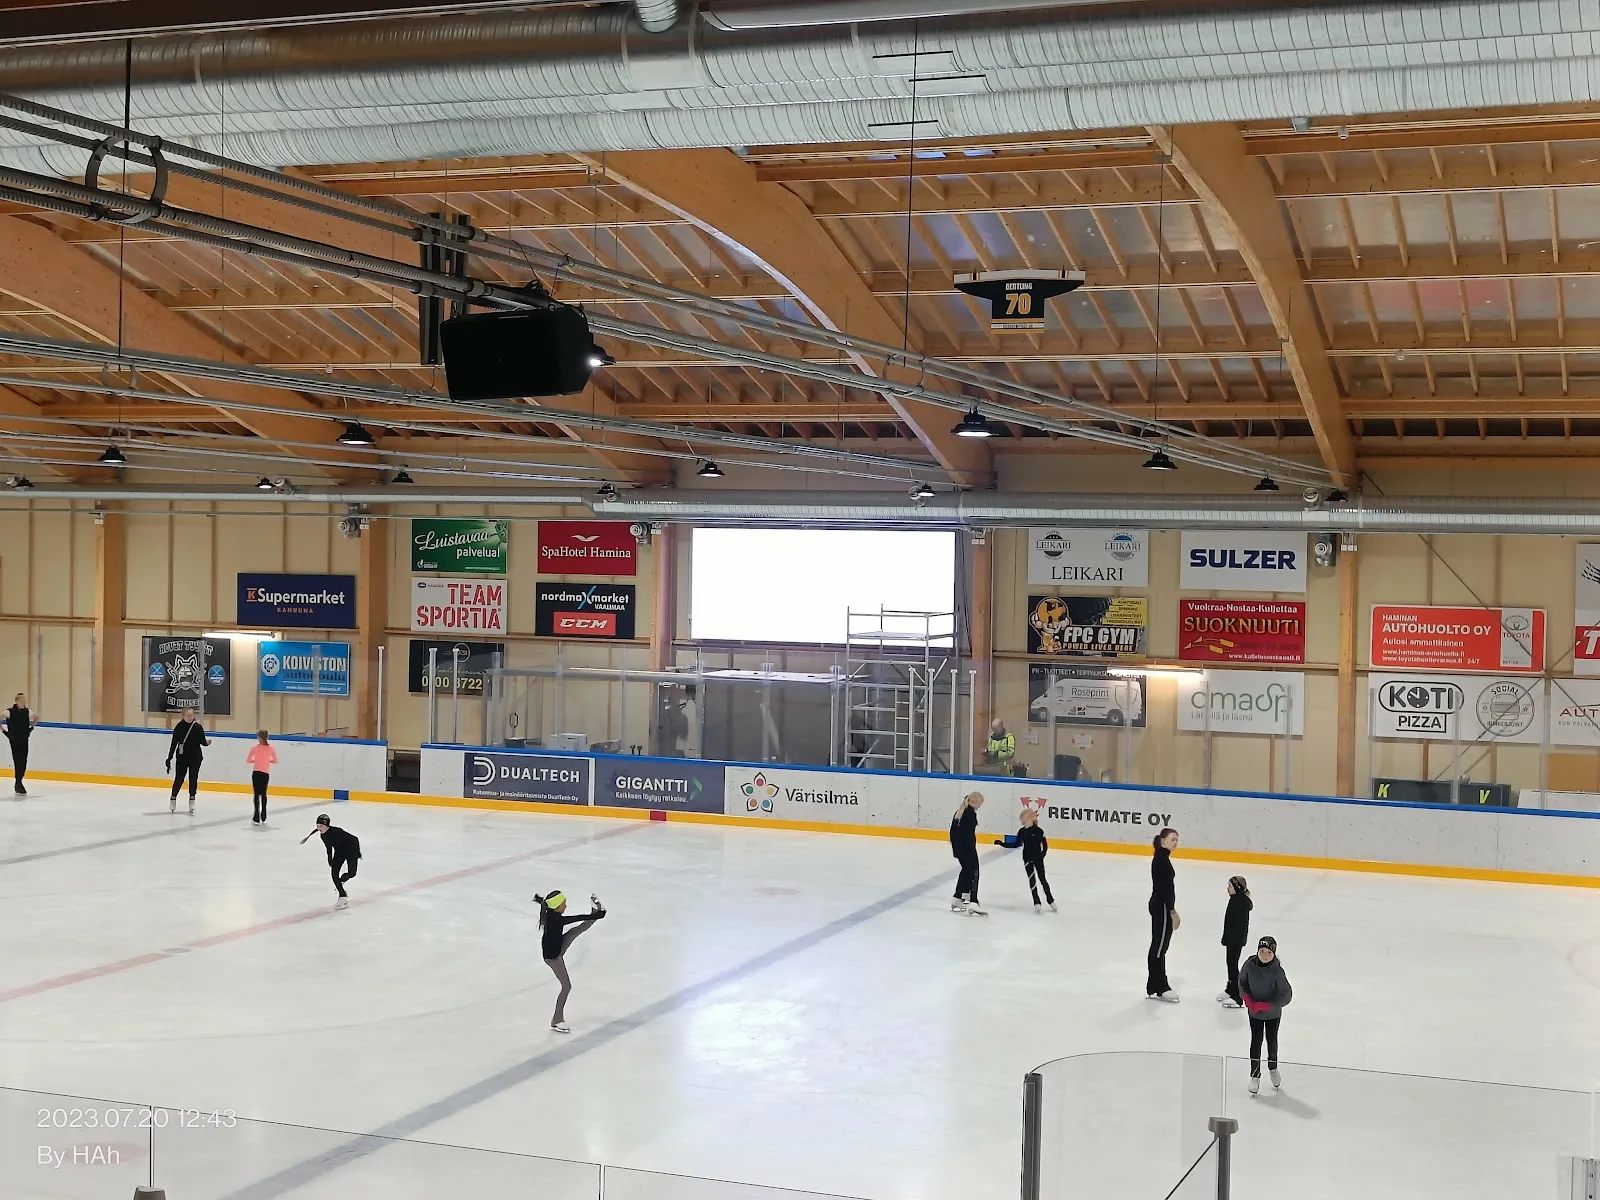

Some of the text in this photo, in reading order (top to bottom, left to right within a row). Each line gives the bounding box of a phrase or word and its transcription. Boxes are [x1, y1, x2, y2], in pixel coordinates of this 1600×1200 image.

[1005, 293, 1031, 315] 70
[414, 531, 488, 551] Luistavaa
[1036, 541, 1071, 549] LEIKARI
[1104, 542, 1141, 551] LEIKARI
[541, 545, 631, 559] SpaHotel Hamina
[1190, 548, 1296, 570] SULZER
[1051, 566, 1123, 581] LEIKARI
[447, 583, 502, 606] TEAM
[594, 603, 626, 611] VAALIMAA
[416, 605, 501, 629] SPORTIA
[560, 618, 608, 628] CCM
[1382, 614, 1417, 622] HAMINAN
[1184, 617, 1301, 635] SUOKNUUTI
[1382, 622, 1491, 635] AUTOHUOLTO OY
[1063, 626, 1135, 645] FPC GYM
[1383, 637, 1464, 647] Autosi ammattilainen
[1063, 642, 1088, 650] POWER
[1091, 643, 1112, 651] LIVES
[1071, 687, 1109, 698] Roseprint
[1390, 685, 1453, 709] KOTI
[1490, 685, 1519, 695] SOCIAL
[1398, 715, 1442, 728] PIZZA
[500, 766, 580, 783] DUALTECH
[615, 776, 688, 792] GIGANTTI
[1377, 783, 1390, 798] K
[785, 788, 858, 806] Värisilmä
[1479, 789, 1490, 804] V
[1048, 806, 1172, 826] RENTMATE OY
